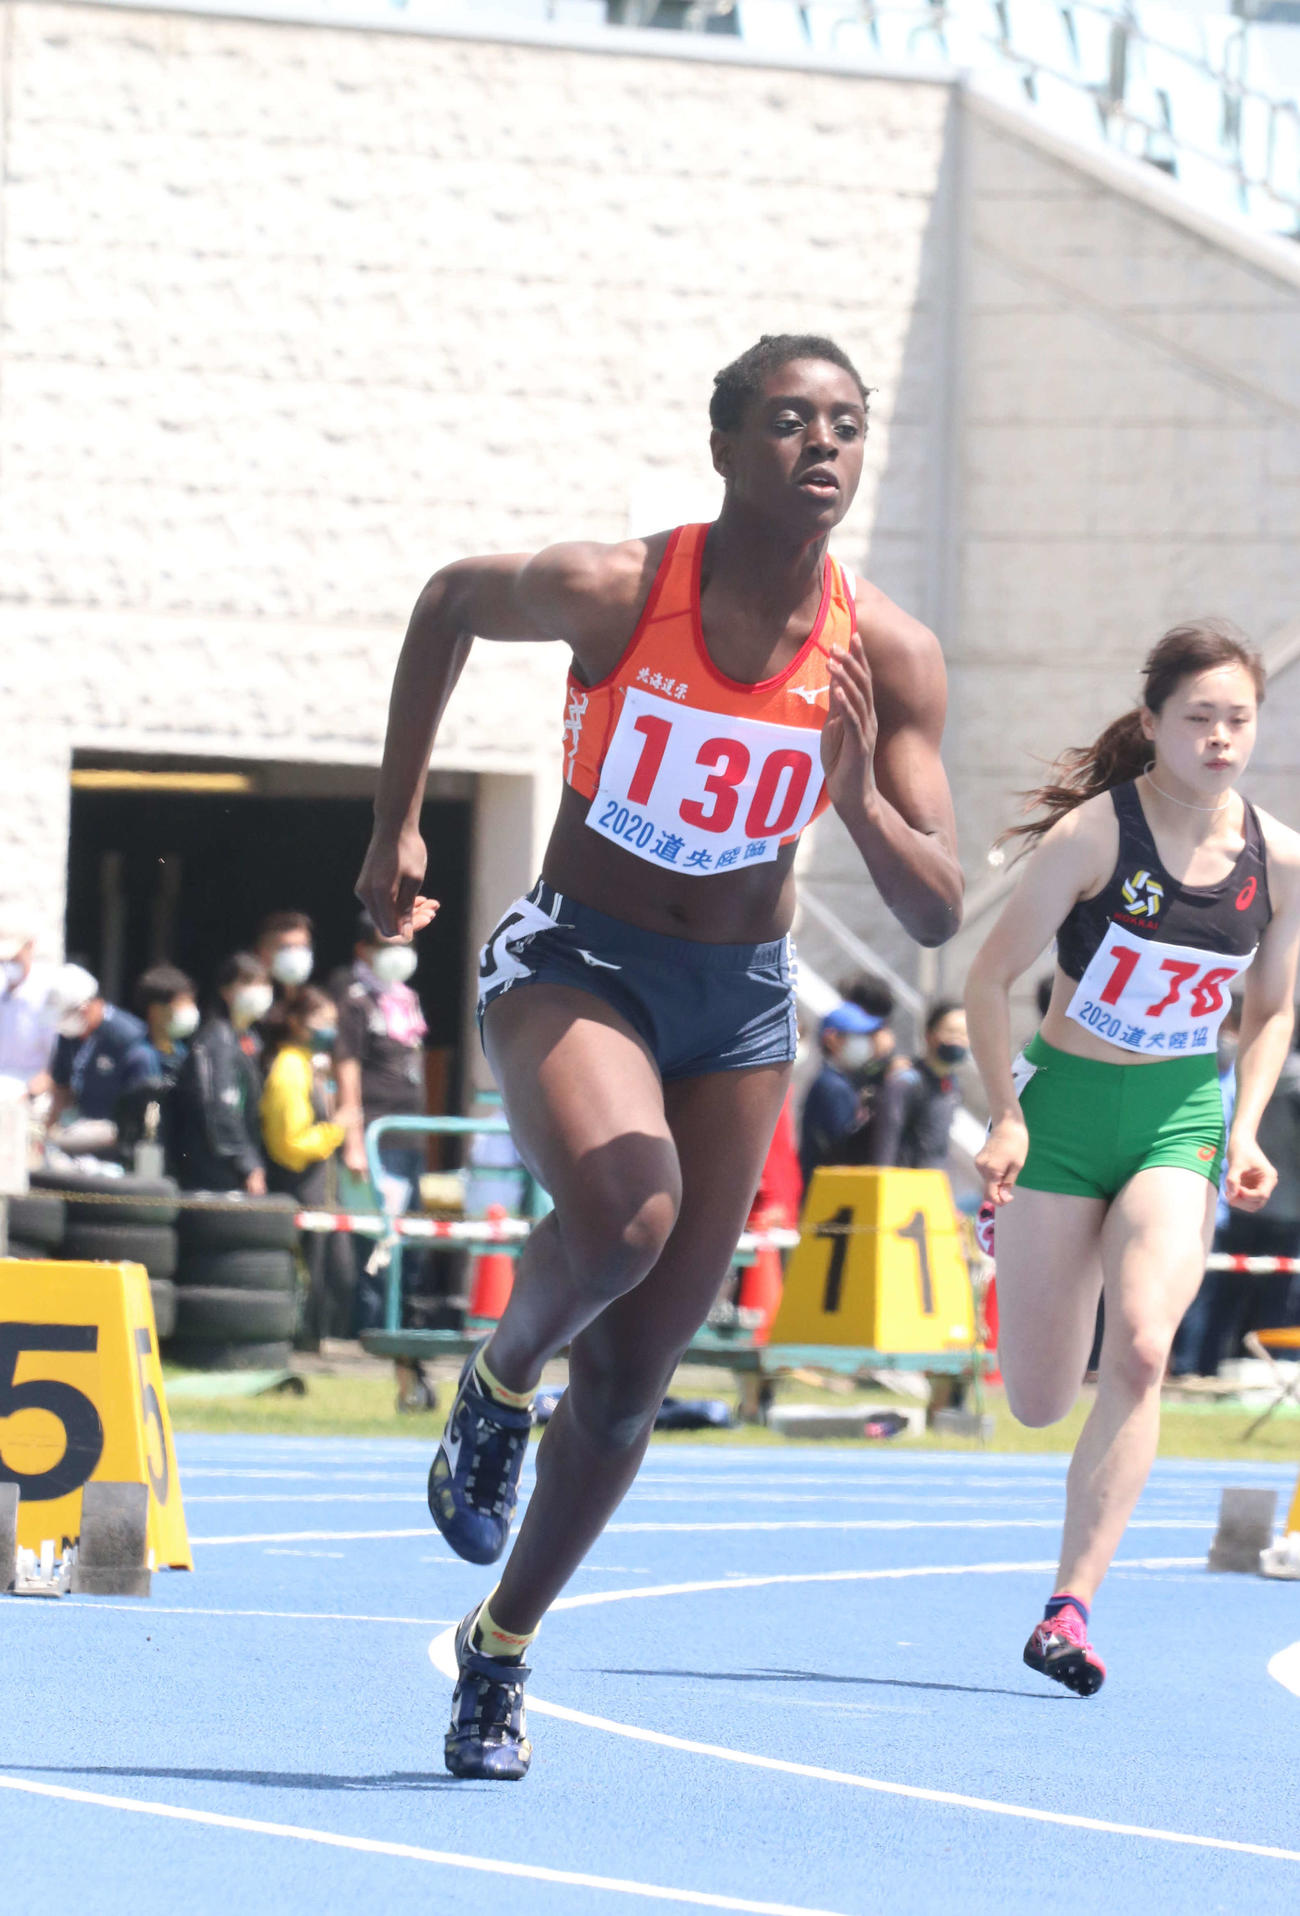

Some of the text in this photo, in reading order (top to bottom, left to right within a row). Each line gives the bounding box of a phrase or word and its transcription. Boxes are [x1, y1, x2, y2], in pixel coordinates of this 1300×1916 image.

[626, 714, 813, 839] 130
[1099, 945, 1239, 1018] 176
[815, 1205, 854, 1315] 1
[896, 1210, 934, 1315] 1
[0, 1321, 104, 1502] 5
[134, 1328, 169, 1506] 5
